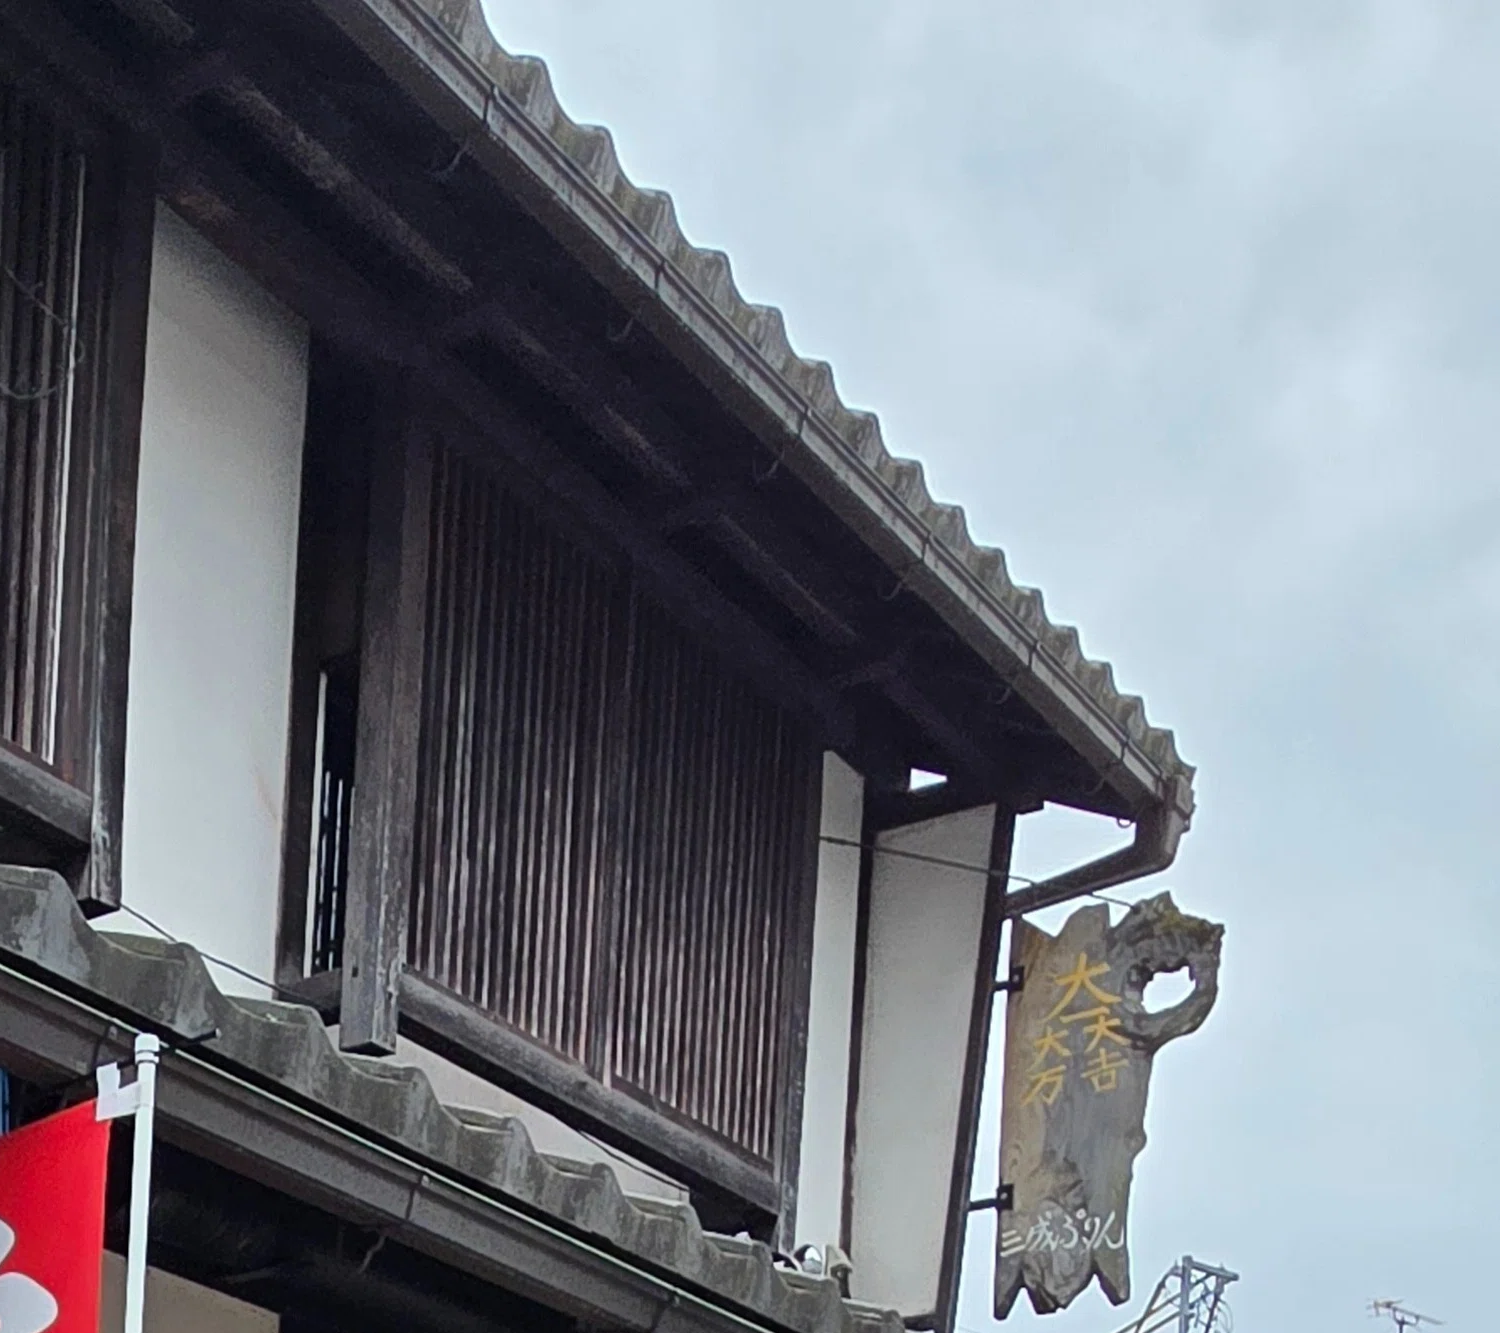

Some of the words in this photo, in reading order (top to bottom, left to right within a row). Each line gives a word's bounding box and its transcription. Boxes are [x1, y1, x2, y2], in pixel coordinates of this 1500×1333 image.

[1000, 1208, 1124, 1257] 三成ぷりん
